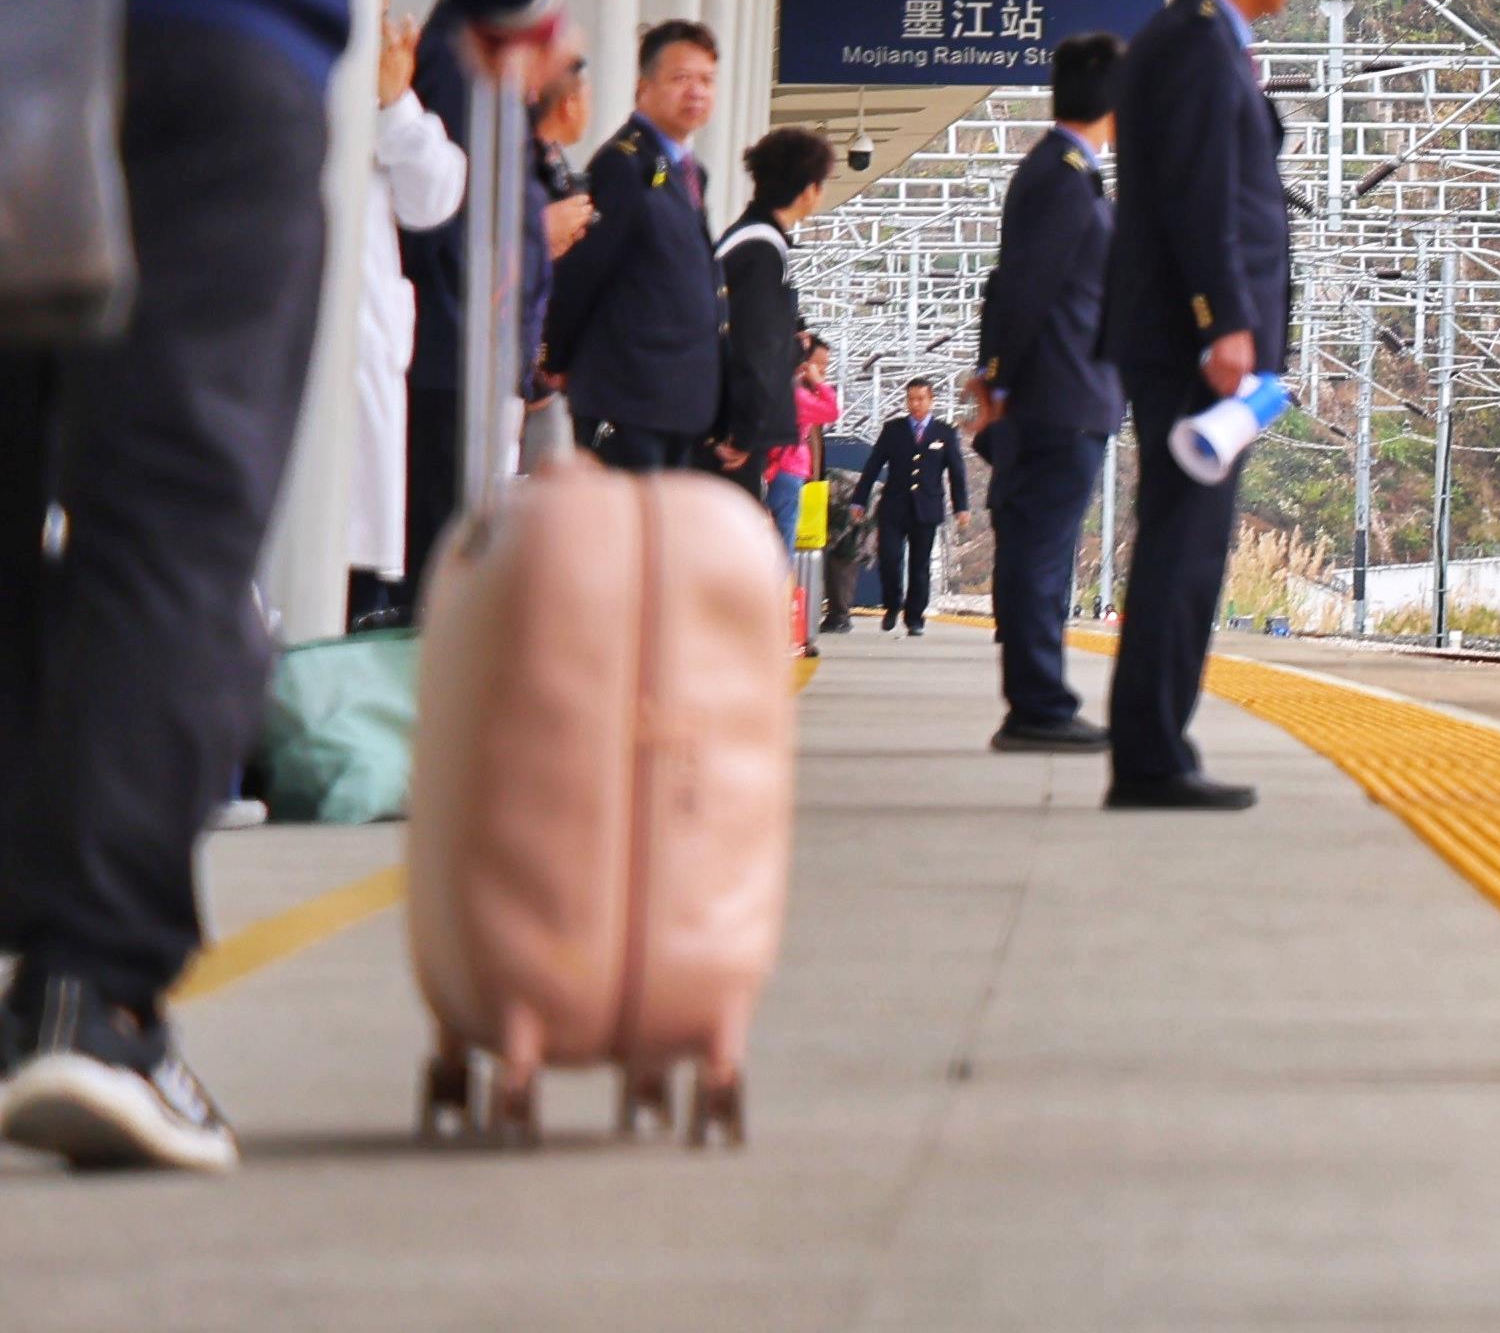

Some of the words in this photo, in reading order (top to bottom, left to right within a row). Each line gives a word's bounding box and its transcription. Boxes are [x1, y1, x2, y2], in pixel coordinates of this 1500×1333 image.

[901, 0, 1043, 40] 墨江站
[842, 46, 928, 67] Mojiang
[933, 46, 1019, 68] Railway
